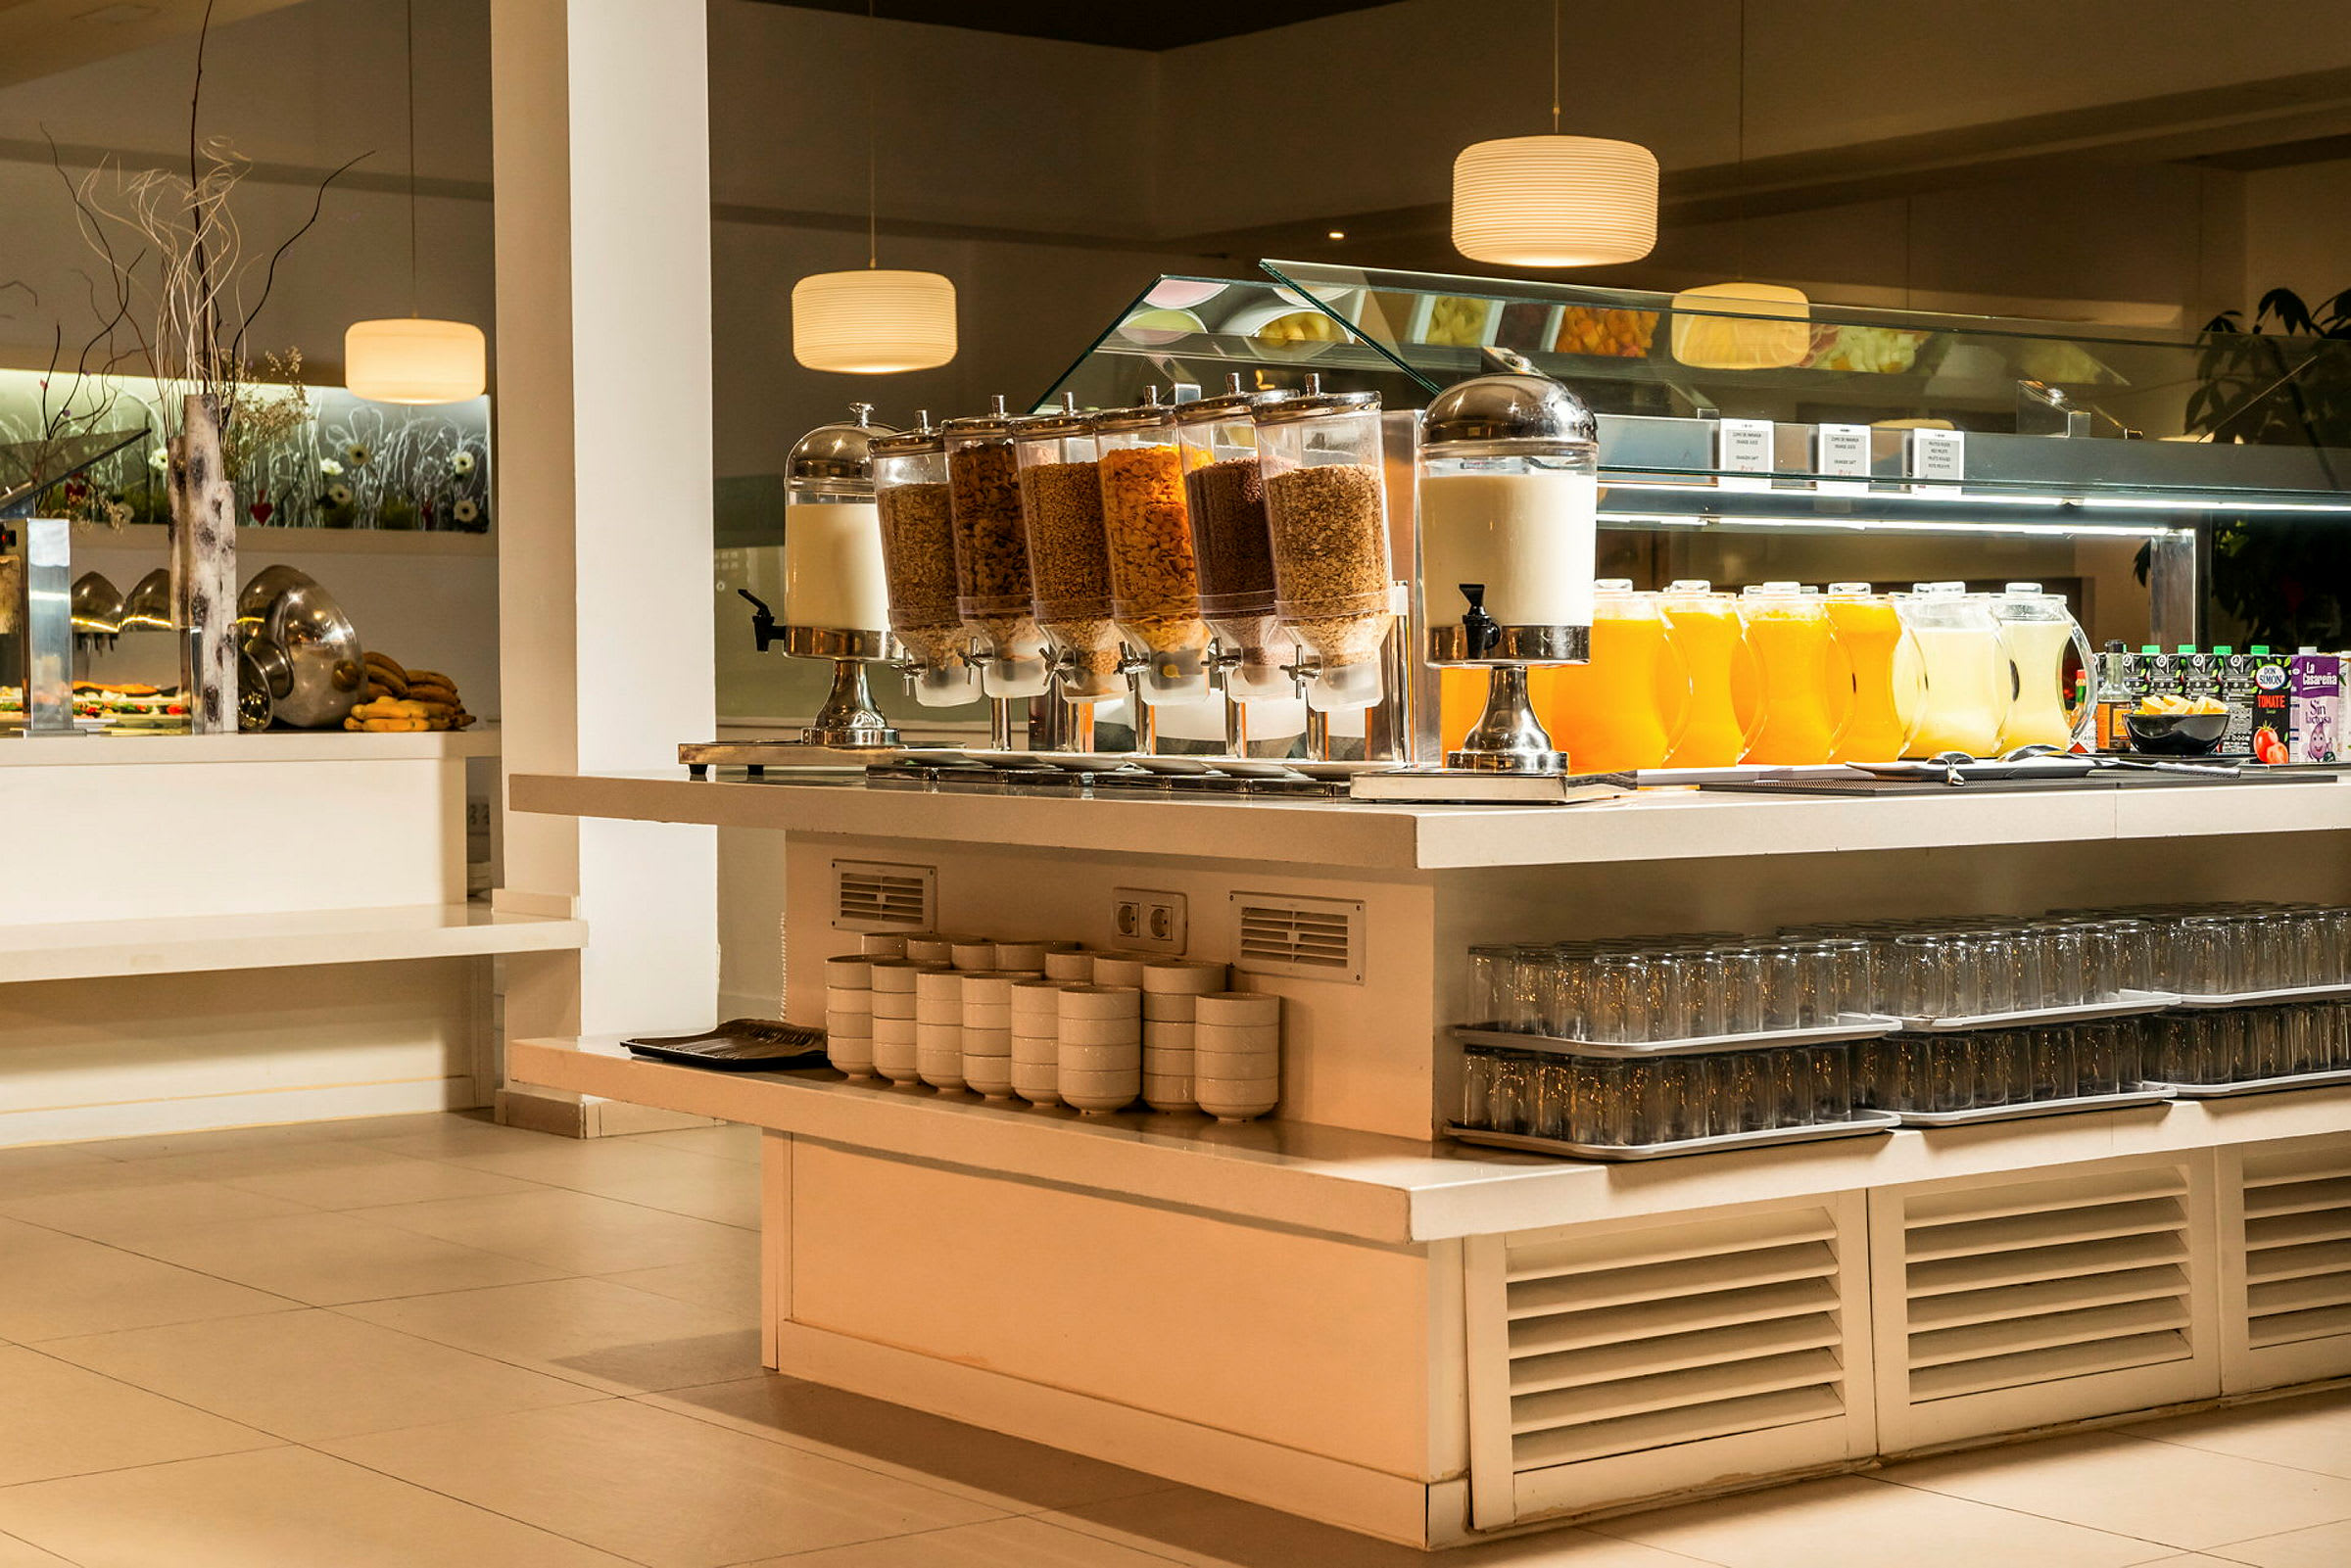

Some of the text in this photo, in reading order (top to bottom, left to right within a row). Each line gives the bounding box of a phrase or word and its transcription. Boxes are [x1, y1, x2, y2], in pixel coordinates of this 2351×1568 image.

[2306, 662, 2315, 674] La
[2257, 694, 2285, 708] TOMATE
[2310, 699, 2327, 715] Sin
